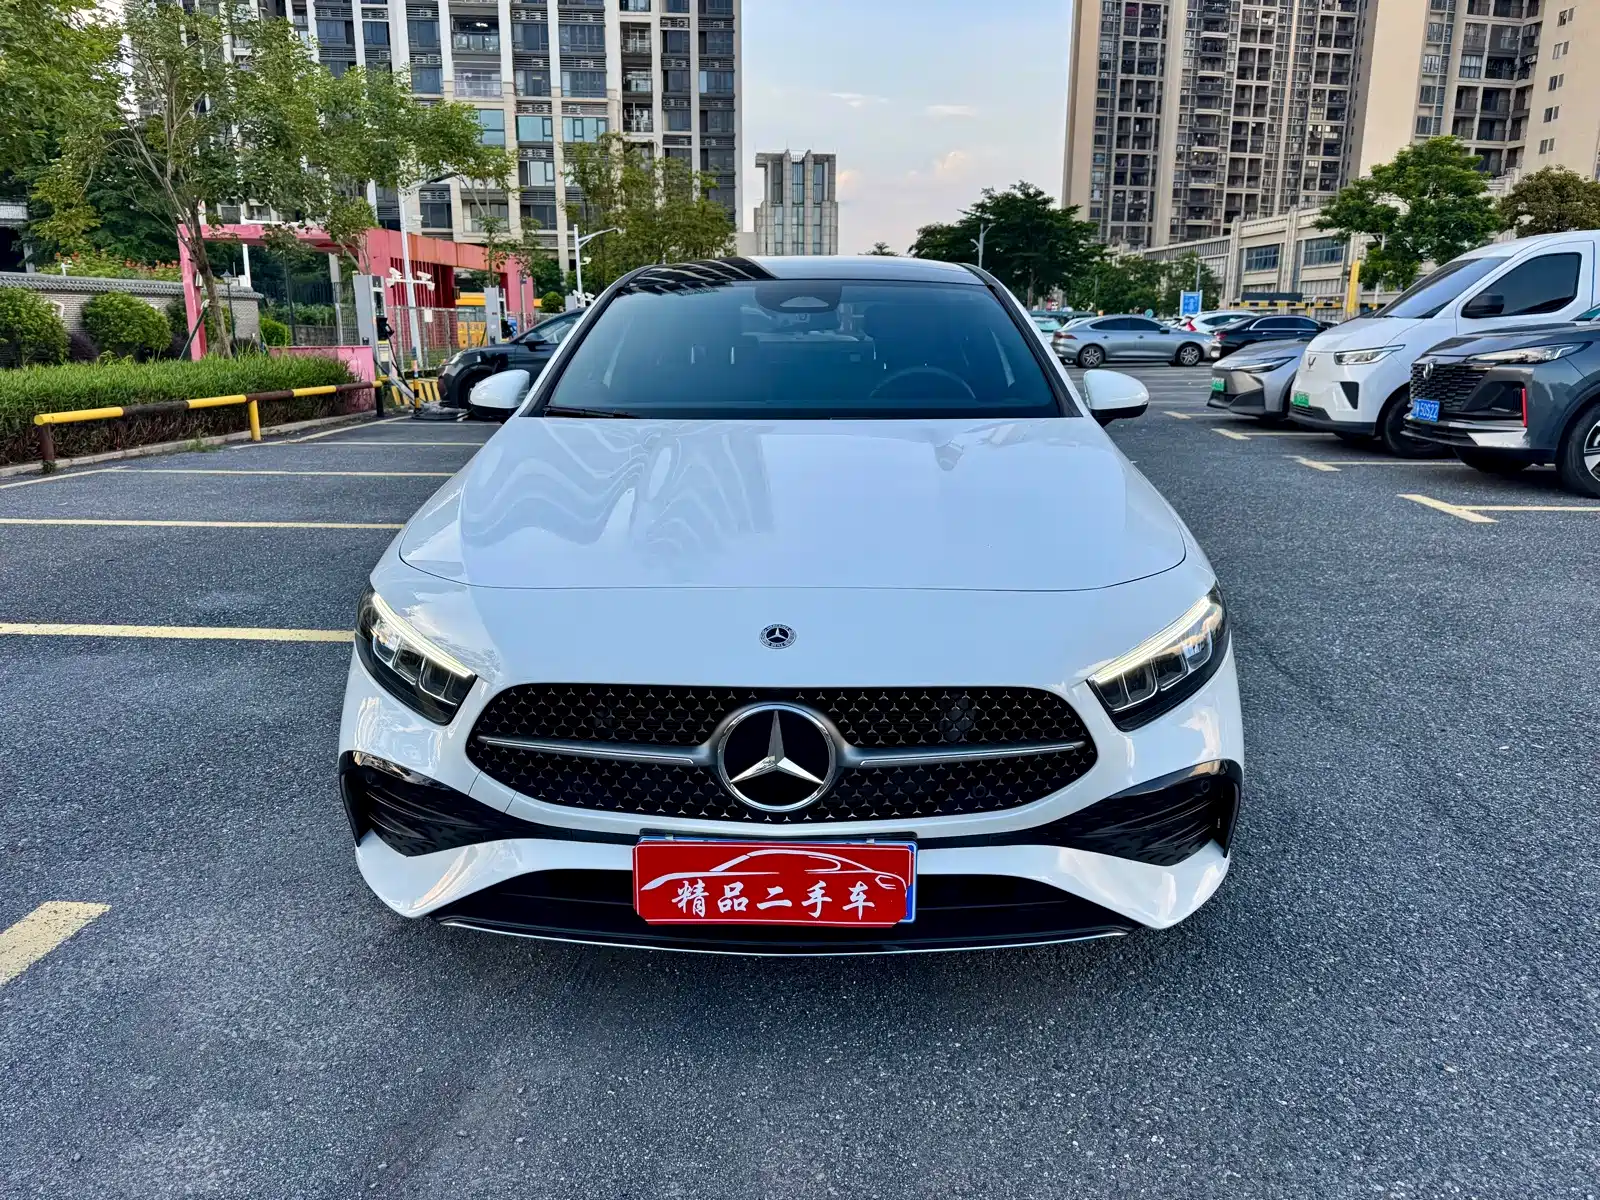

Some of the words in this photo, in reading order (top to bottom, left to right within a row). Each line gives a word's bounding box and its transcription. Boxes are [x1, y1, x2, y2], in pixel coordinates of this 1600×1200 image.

[672, 880, 875, 920] 精品二手车
